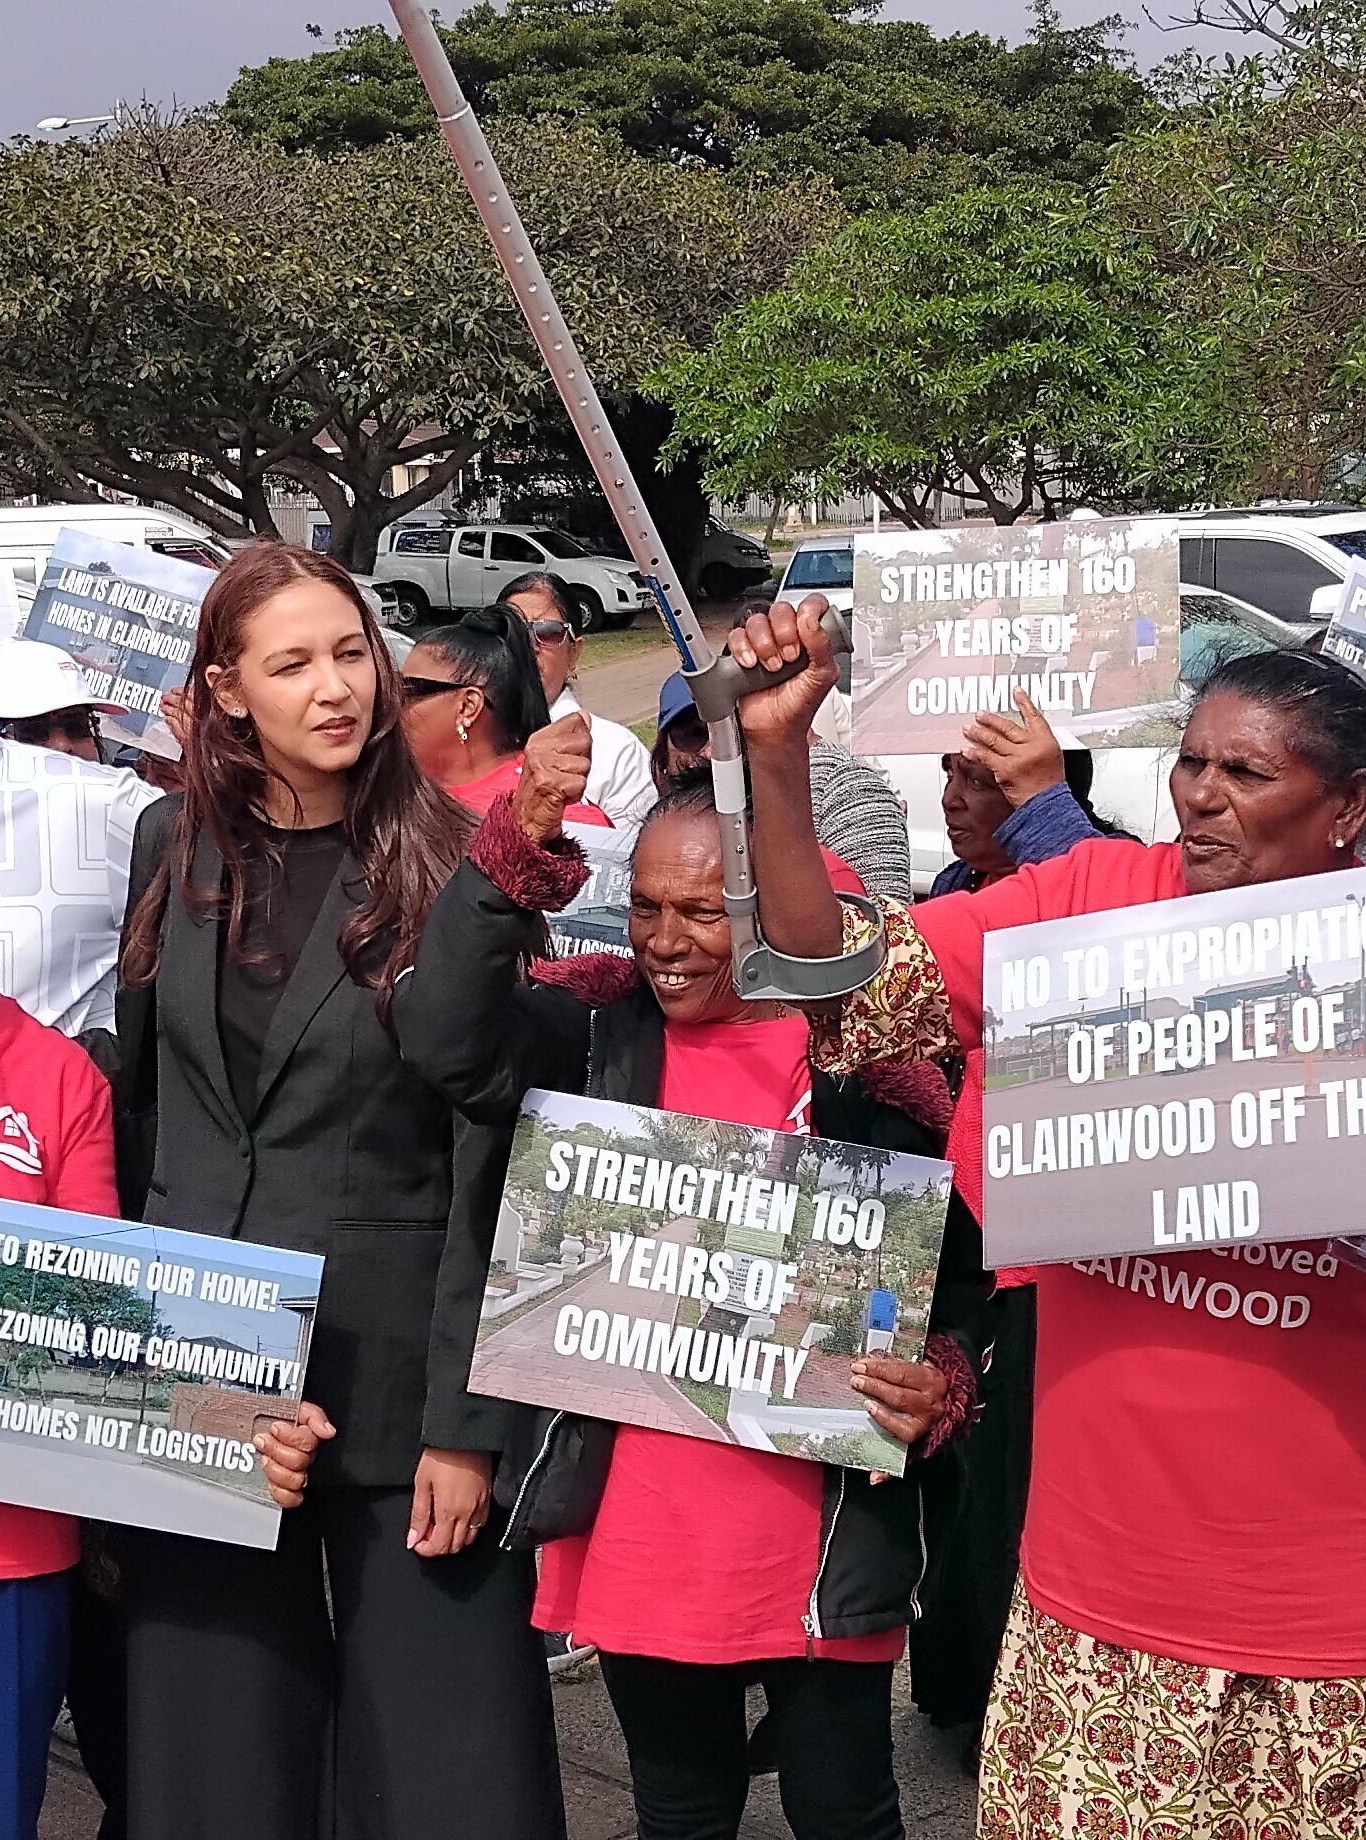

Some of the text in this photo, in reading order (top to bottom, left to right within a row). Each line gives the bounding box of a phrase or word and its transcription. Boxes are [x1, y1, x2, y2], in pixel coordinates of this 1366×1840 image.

[58, 568, 201, 631] LAND IS AVAILABLE FO
[880, 555, 1135, 604] STRENGTHEN 160
[47, 601, 191, 664] HOMES IN CLAIRWOOD
[935, 613, 1078, 658] YEARS OF
[1335, 639, 1364, 666] NOT
[84, 669, 163, 718] OUR HERITA
[907, 671, 1096, 716] COMMUNITY
[1001, 955, 1050, 1013] NO
[1062, 944, 1109, 1002] TO
[1067, 992, 1345, 1085] OF PEOPLE OF
[988, 1097, 1216, 1179] CLAIRWOOD
[1231, 1085, 1308, 1149] OFF
[545, 1140, 885, 1252] STRENGTHEN 160
[1151, 1180, 1261, 1246] LAND
[25, 1238, 140, 1289] REZONING
[146, 1260, 194, 1297] OUR
[199, 1271, 280, 1313] HOME!
[608, 1229, 736, 1304] YEARS
[745, 1258, 800, 1316] OF
[91, 1327, 140, 1363] OUR
[145, 1336, 301, 1393] COMMUNITY!
[552, 1303, 809, 1400] COMMUNITY
[84, 1415, 132, 1452] NOT
[137, 1423, 256, 1474] LOGISTICS
